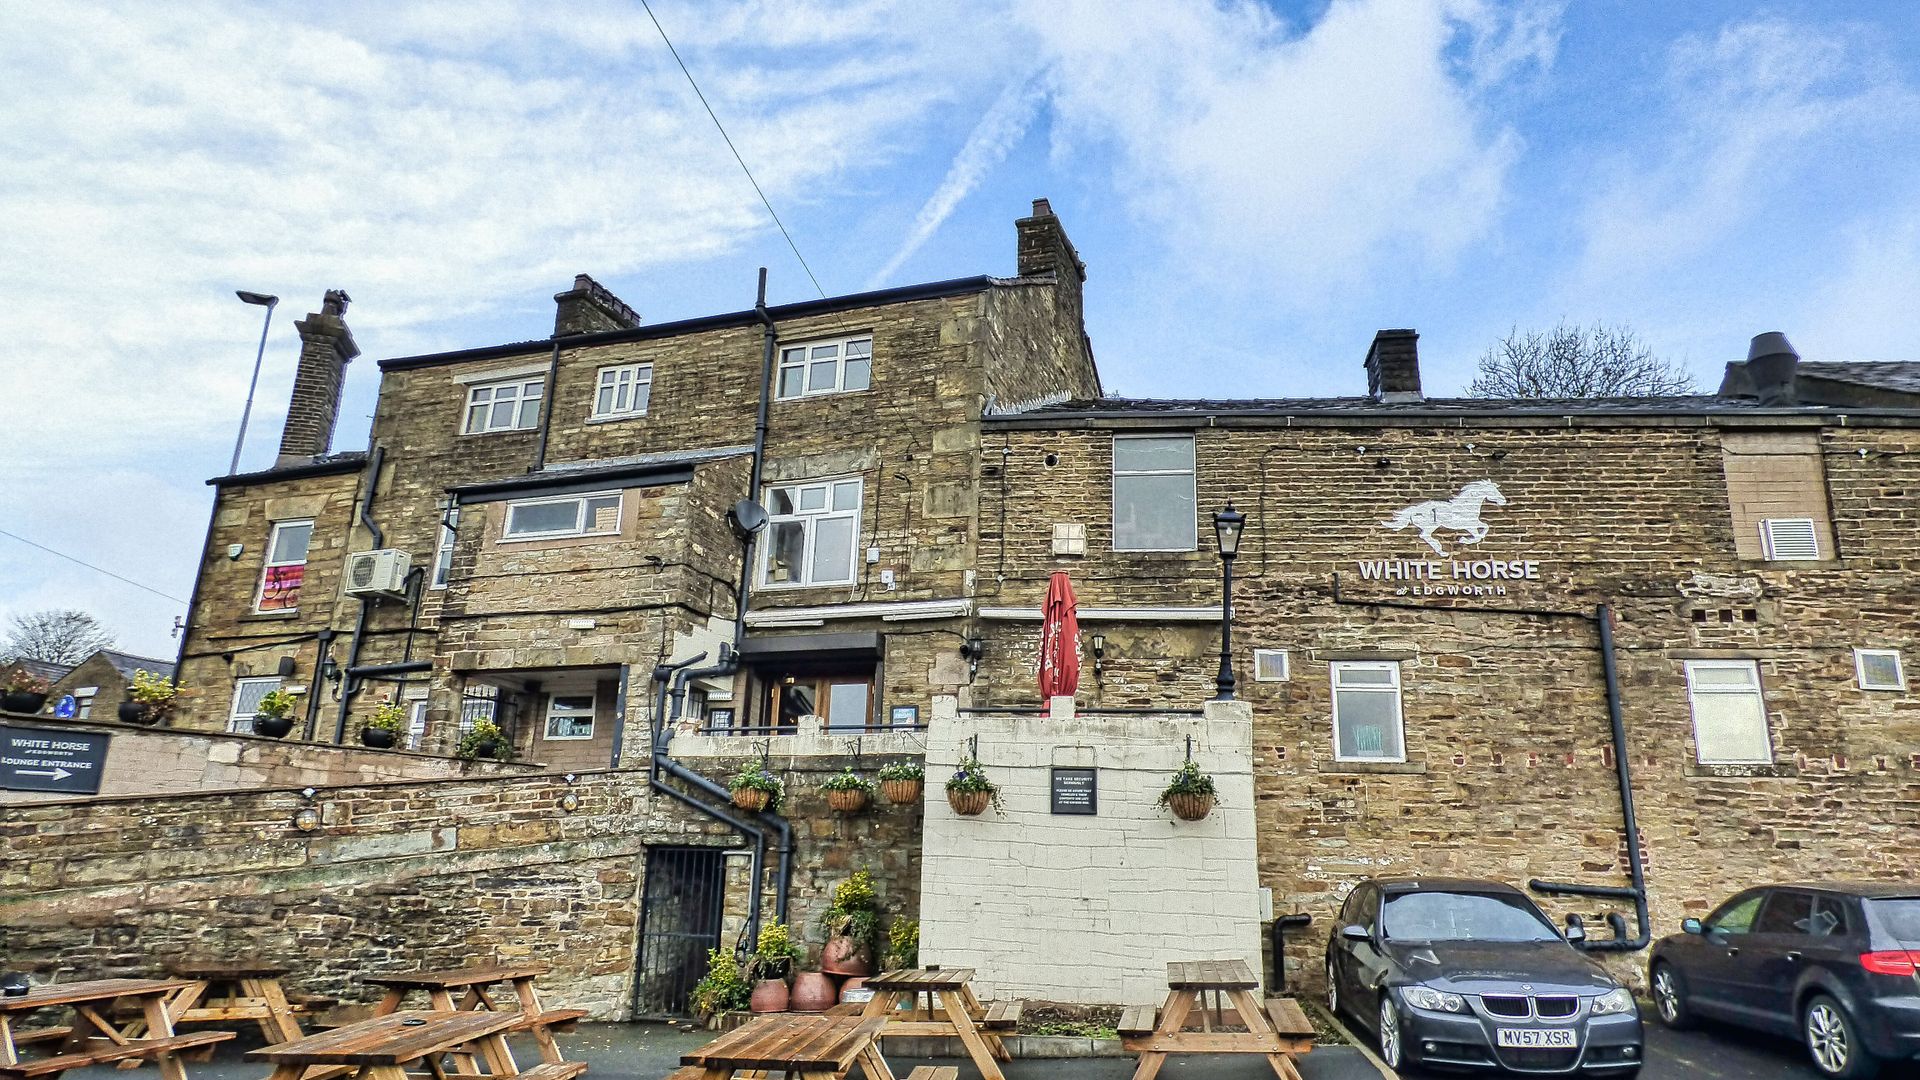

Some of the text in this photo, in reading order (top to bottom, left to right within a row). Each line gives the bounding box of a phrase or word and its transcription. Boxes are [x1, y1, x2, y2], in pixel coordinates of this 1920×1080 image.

[1358, 560, 1541, 580] WHITE HORSE
[1396, 586, 1507, 596] at EDGWORTH
[11, 738, 91, 751] WHITE HORSE
[1, 757, 93, 769] LOUNGE ENTRANCE
[1504, 1031, 1570, 1044] MV57 XSR
